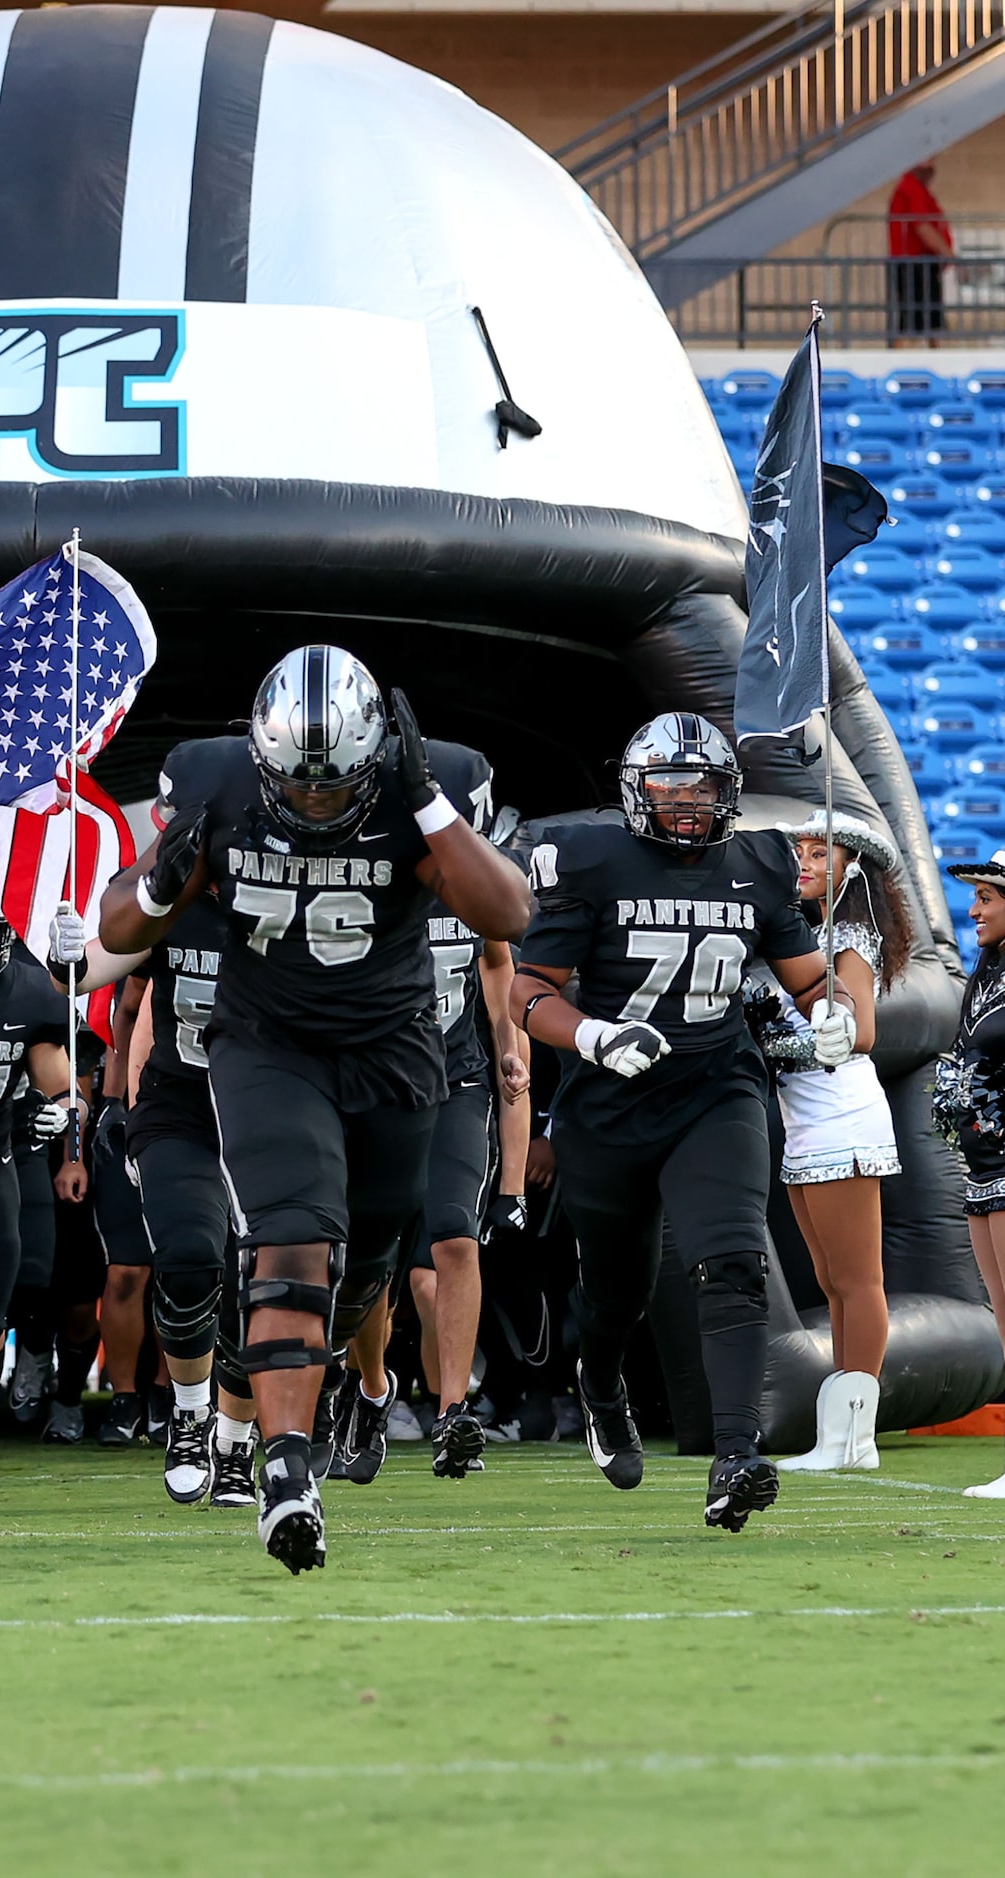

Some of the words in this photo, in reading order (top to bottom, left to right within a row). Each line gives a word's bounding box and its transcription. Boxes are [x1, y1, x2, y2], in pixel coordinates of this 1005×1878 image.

[227, 848, 393, 887] PANTHERS
[528, 844, 559, 890] 0
[232, 881, 376, 967] 76
[617, 899, 755, 930] PANTHERS
[616, 930, 747, 1024] 70
